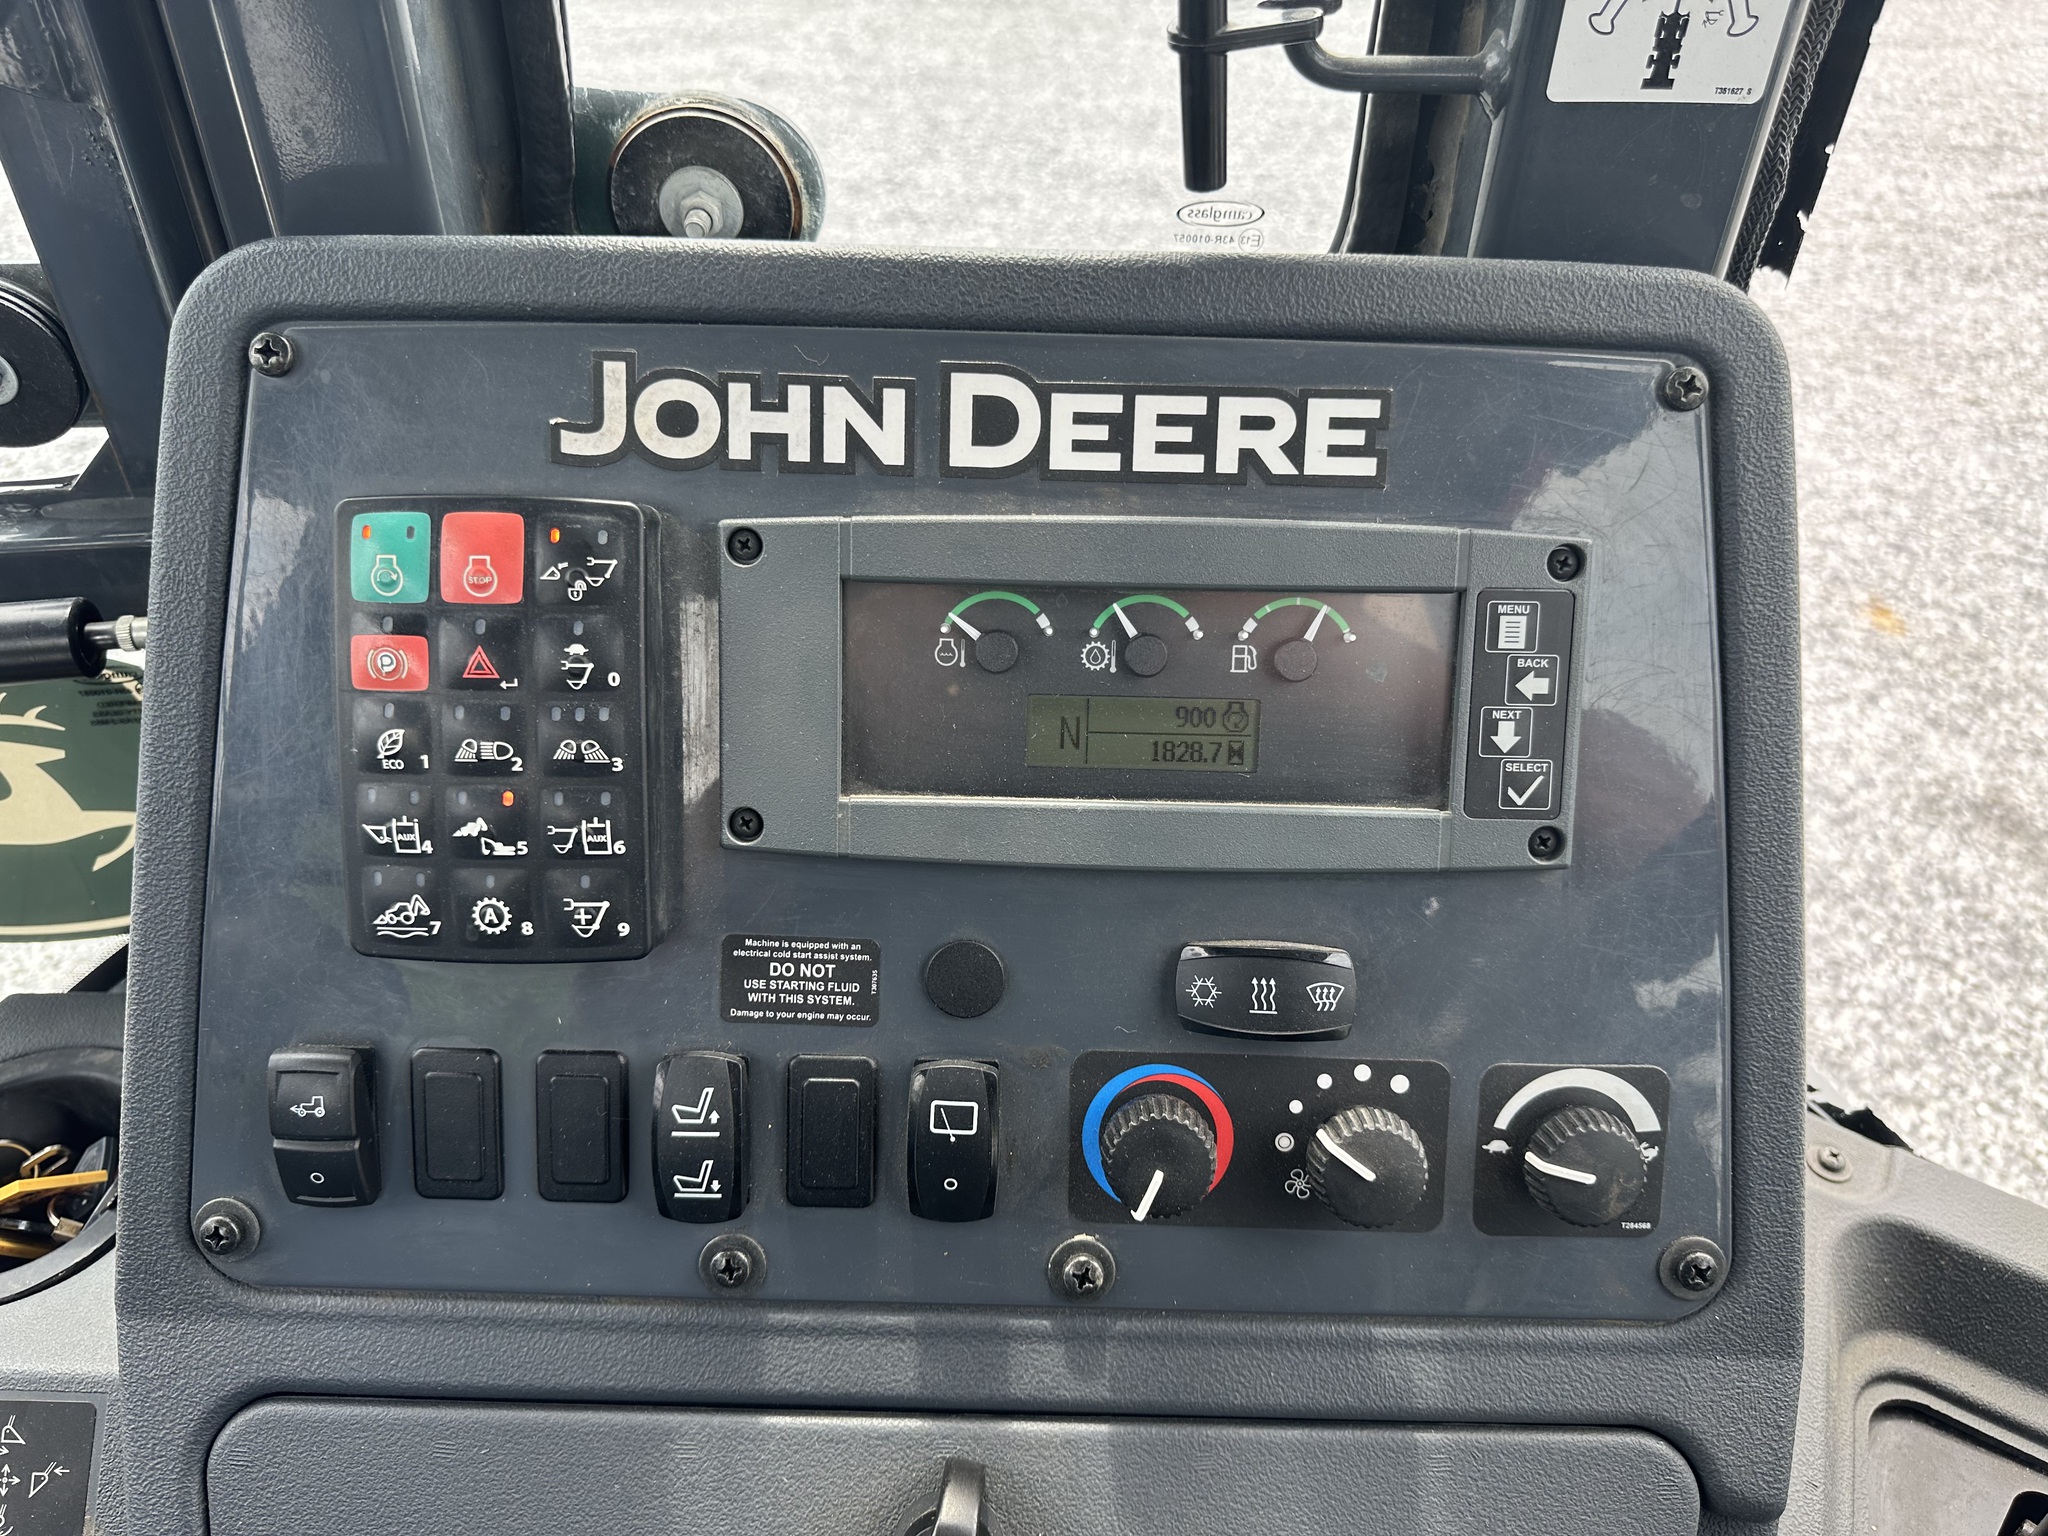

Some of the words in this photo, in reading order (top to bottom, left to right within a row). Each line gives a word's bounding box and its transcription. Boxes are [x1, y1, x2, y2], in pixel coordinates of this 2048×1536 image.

[560, 359, 907, 467] JOHN
[948, 371, 1382, 477] DEERE
[468, 575, 492, 584] STOP
[1497, 604, 1530, 614] MENU
[1516, 659, 1549, 668] BACK
[608, 672, 620, 686] 0
[1175, 706, 1217, 728] 900
[1492, 710, 1522, 720] NEXT
[1060, 716, 1080, 750] N
[1151, 740, 1222, 763] 1828.7
[382, 760, 404, 770] ECO
[420, 755, 429, 769] 1
[511, 757, 524, 772] 2
[612, 757, 624, 772] 3
[1504, 763, 1548, 772] SELECT
[397, 833, 416, 842] AUX
[586, 834, 607, 842] AUX
[421, 840, 433, 854] 4
[516, 840, 528, 855] 5
[613, 840, 626, 855] 6
[429, 921, 442, 936] 7
[521, 922, 534, 936] 8
[617, 923, 630, 937] 9
[745, 938, 780, 948] Machine
[782, 940, 789, 948] is
[791, 940, 830, 950] equipped
[832, 942, 848, 950] with
[733, 949, 771, 958] electrical
[773, 950, 790, 958] cold
[792, 951, 812, 959] start
[813, 952, 838, 960] assist
[840, 953, 872, 962] system.
[769, 962, 795, 977] DO
[800, 963, 836, 978] NOT
[744, 979, 766, 990] USE
[769, 980, 825, 992] STARTING
[827, 982, 860, 993] FLUID
[748, 992, 776, 1003] WITH
[779, 993, 804, 1004] THIS
[807, 994, 855, 1006] SYSTEM.
[730, 1008, 764, 1019] Damage
[766, 1010, 774, 1018] to
[776, 1011, 795, 1020] your
[796, 1011, 825, 1021] engine
[826, 1012, 844, 1022] may
[846, 1013, 872, 1022] occur.
